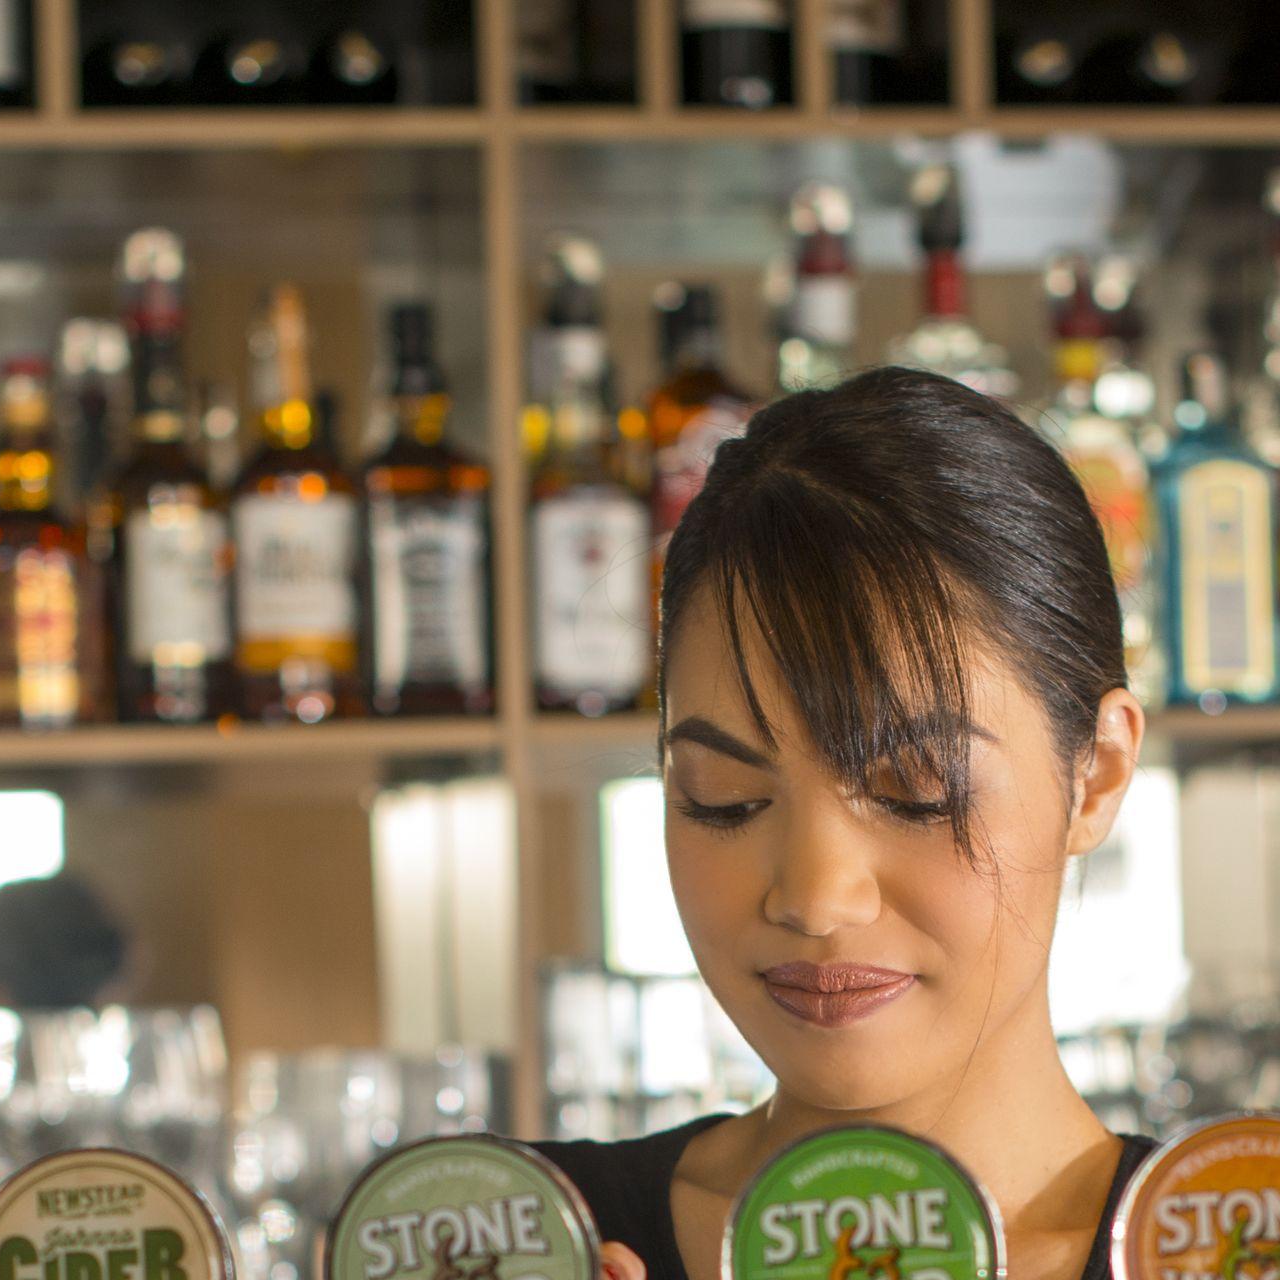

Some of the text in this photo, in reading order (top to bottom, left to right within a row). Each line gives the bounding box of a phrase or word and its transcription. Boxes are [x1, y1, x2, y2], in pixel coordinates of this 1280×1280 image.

[36, 1184, 146, 1218] NEWSTEAD
[358, 1194, 548, 1279] STONE
[760, 1188, 953, 1264] STONE
